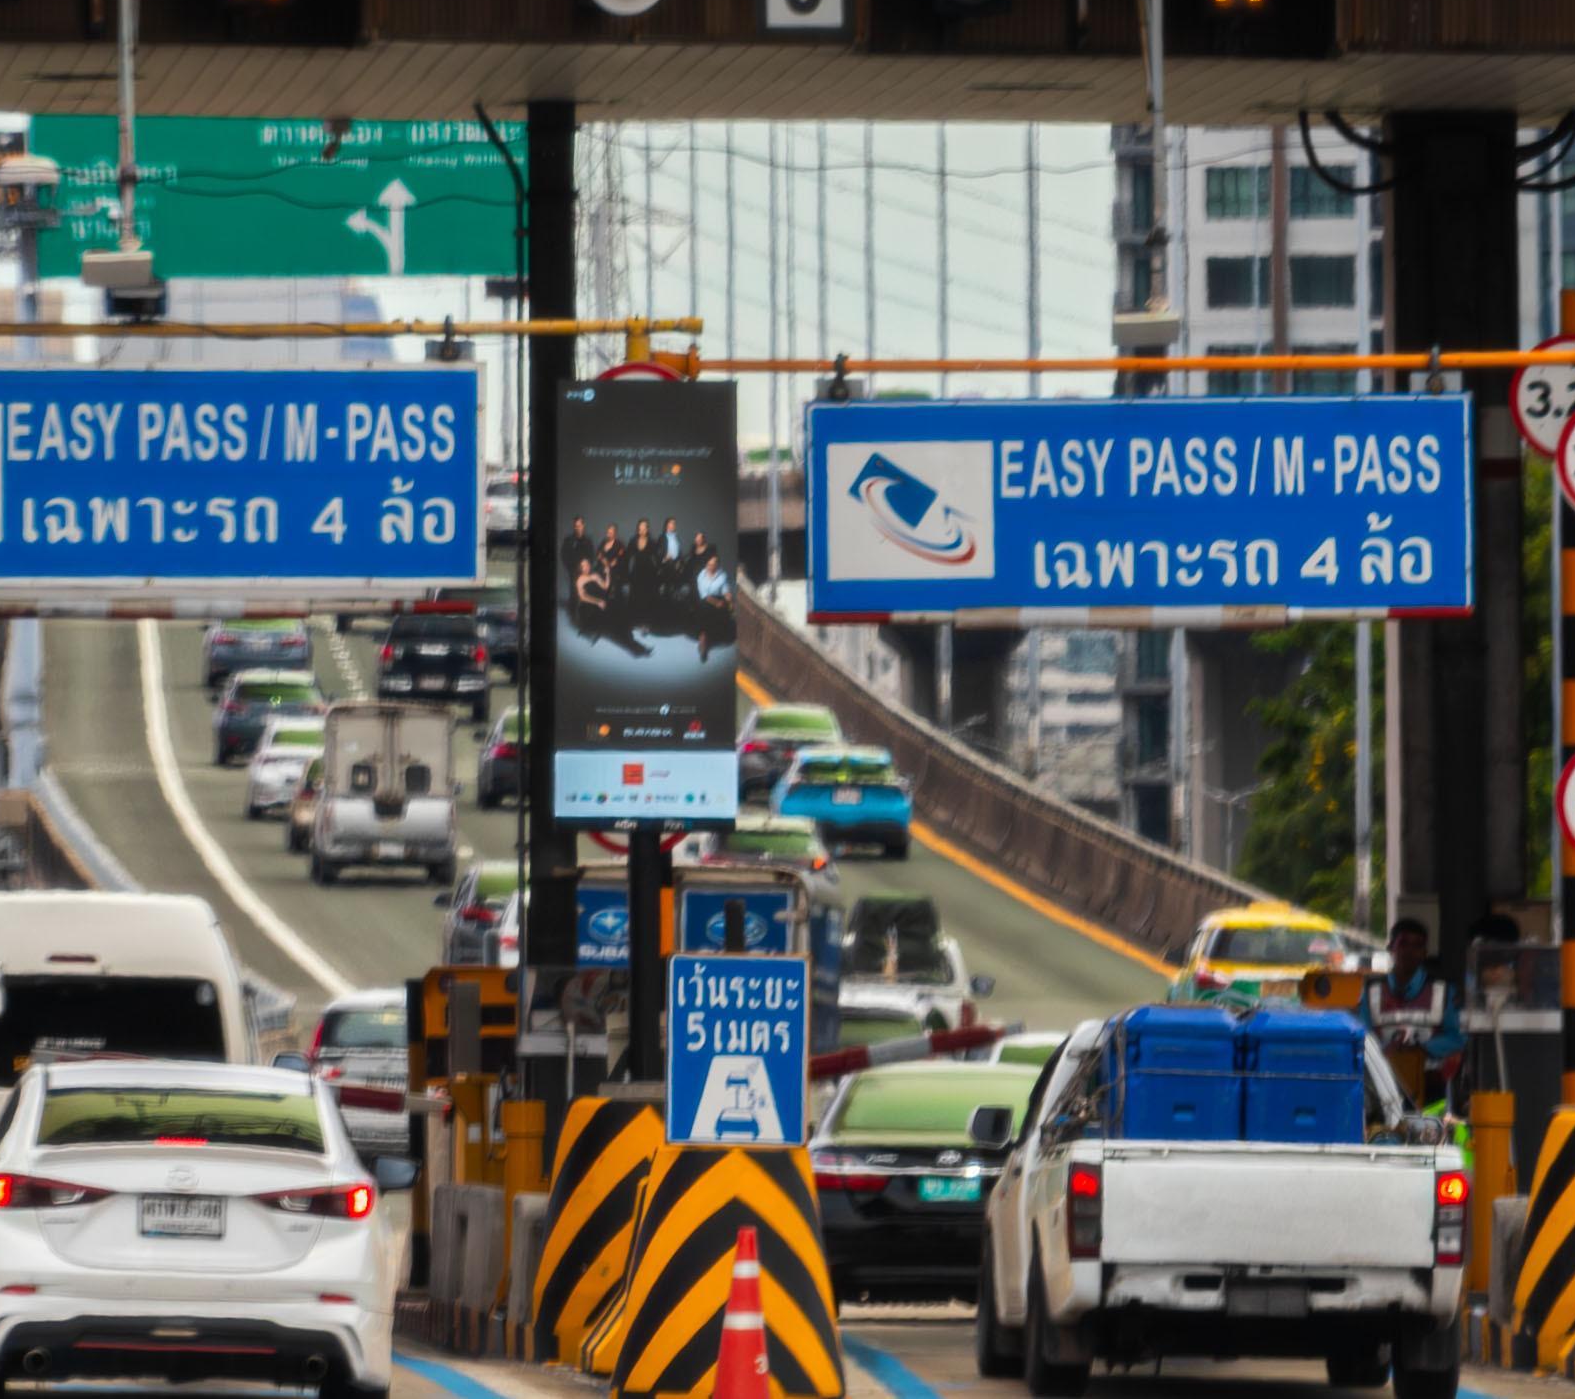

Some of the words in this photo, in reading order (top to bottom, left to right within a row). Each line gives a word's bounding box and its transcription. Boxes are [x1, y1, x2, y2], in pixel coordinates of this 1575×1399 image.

[7, 403, 122, 462] EASY
[1000, 439, 1115, 499] EASY
[21, 496, 279, 545] เฉพาะรถ
[311, 498, 347, 544] 4
[380, 477, 455, 544] ล้อ
[1034, 539, 1278, 590] เฉพาะรถ
[1300, 538, 1339, 587] 4
[1360, 513, 1433, 586] ล้อ
[579, 945, 629, 960] SUBA
[678, 963, 799, 1010] เว้นระยะ
